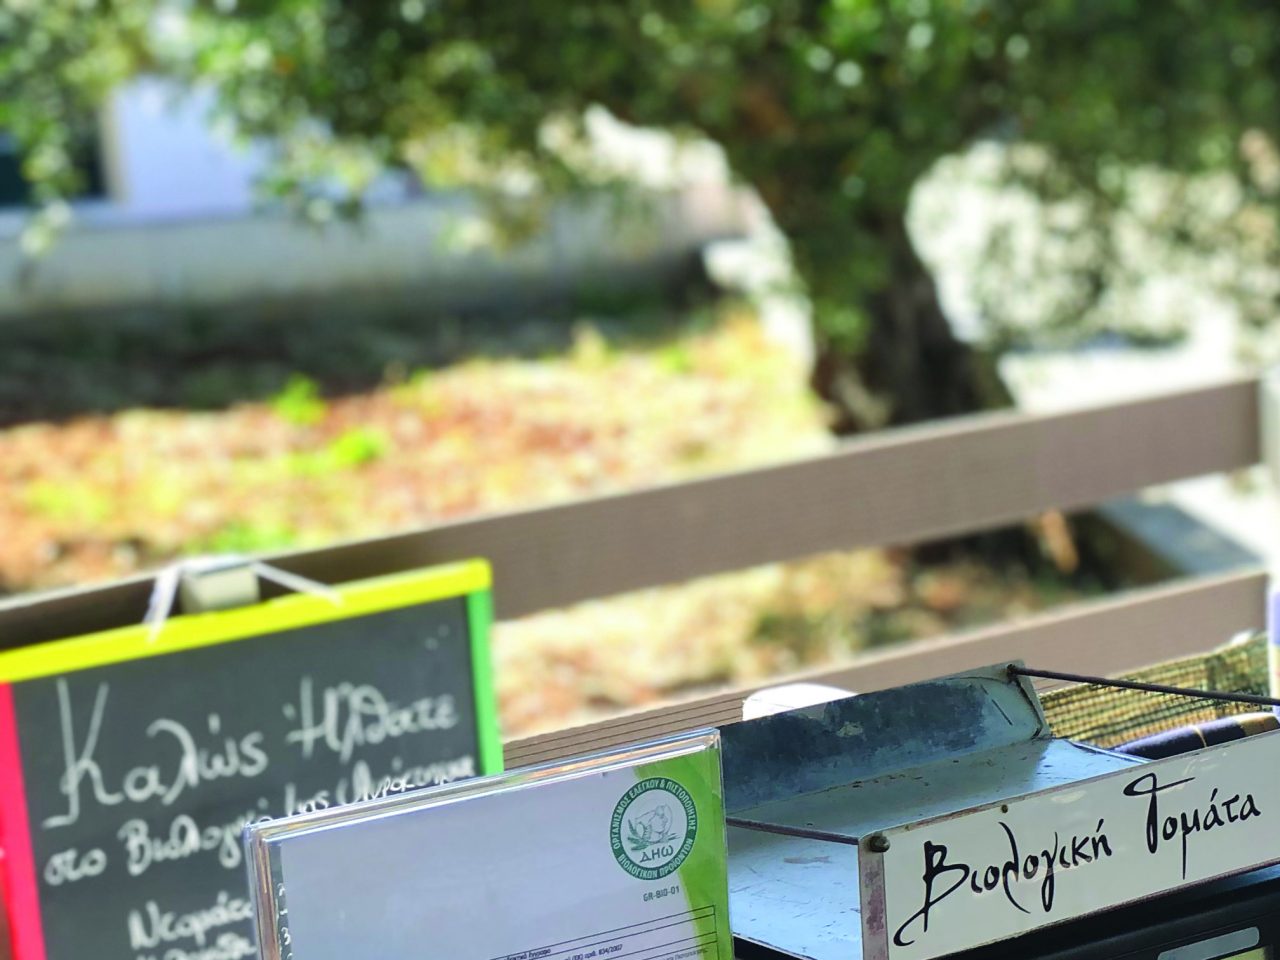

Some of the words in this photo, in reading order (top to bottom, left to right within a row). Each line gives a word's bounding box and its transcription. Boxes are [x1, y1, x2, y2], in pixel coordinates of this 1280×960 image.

[643, 885, 680, 902] GR-BIO-01
[893, 818, 1112, 947] Βιολογική
[1123, 772, 1262, 879] Τομάτα
